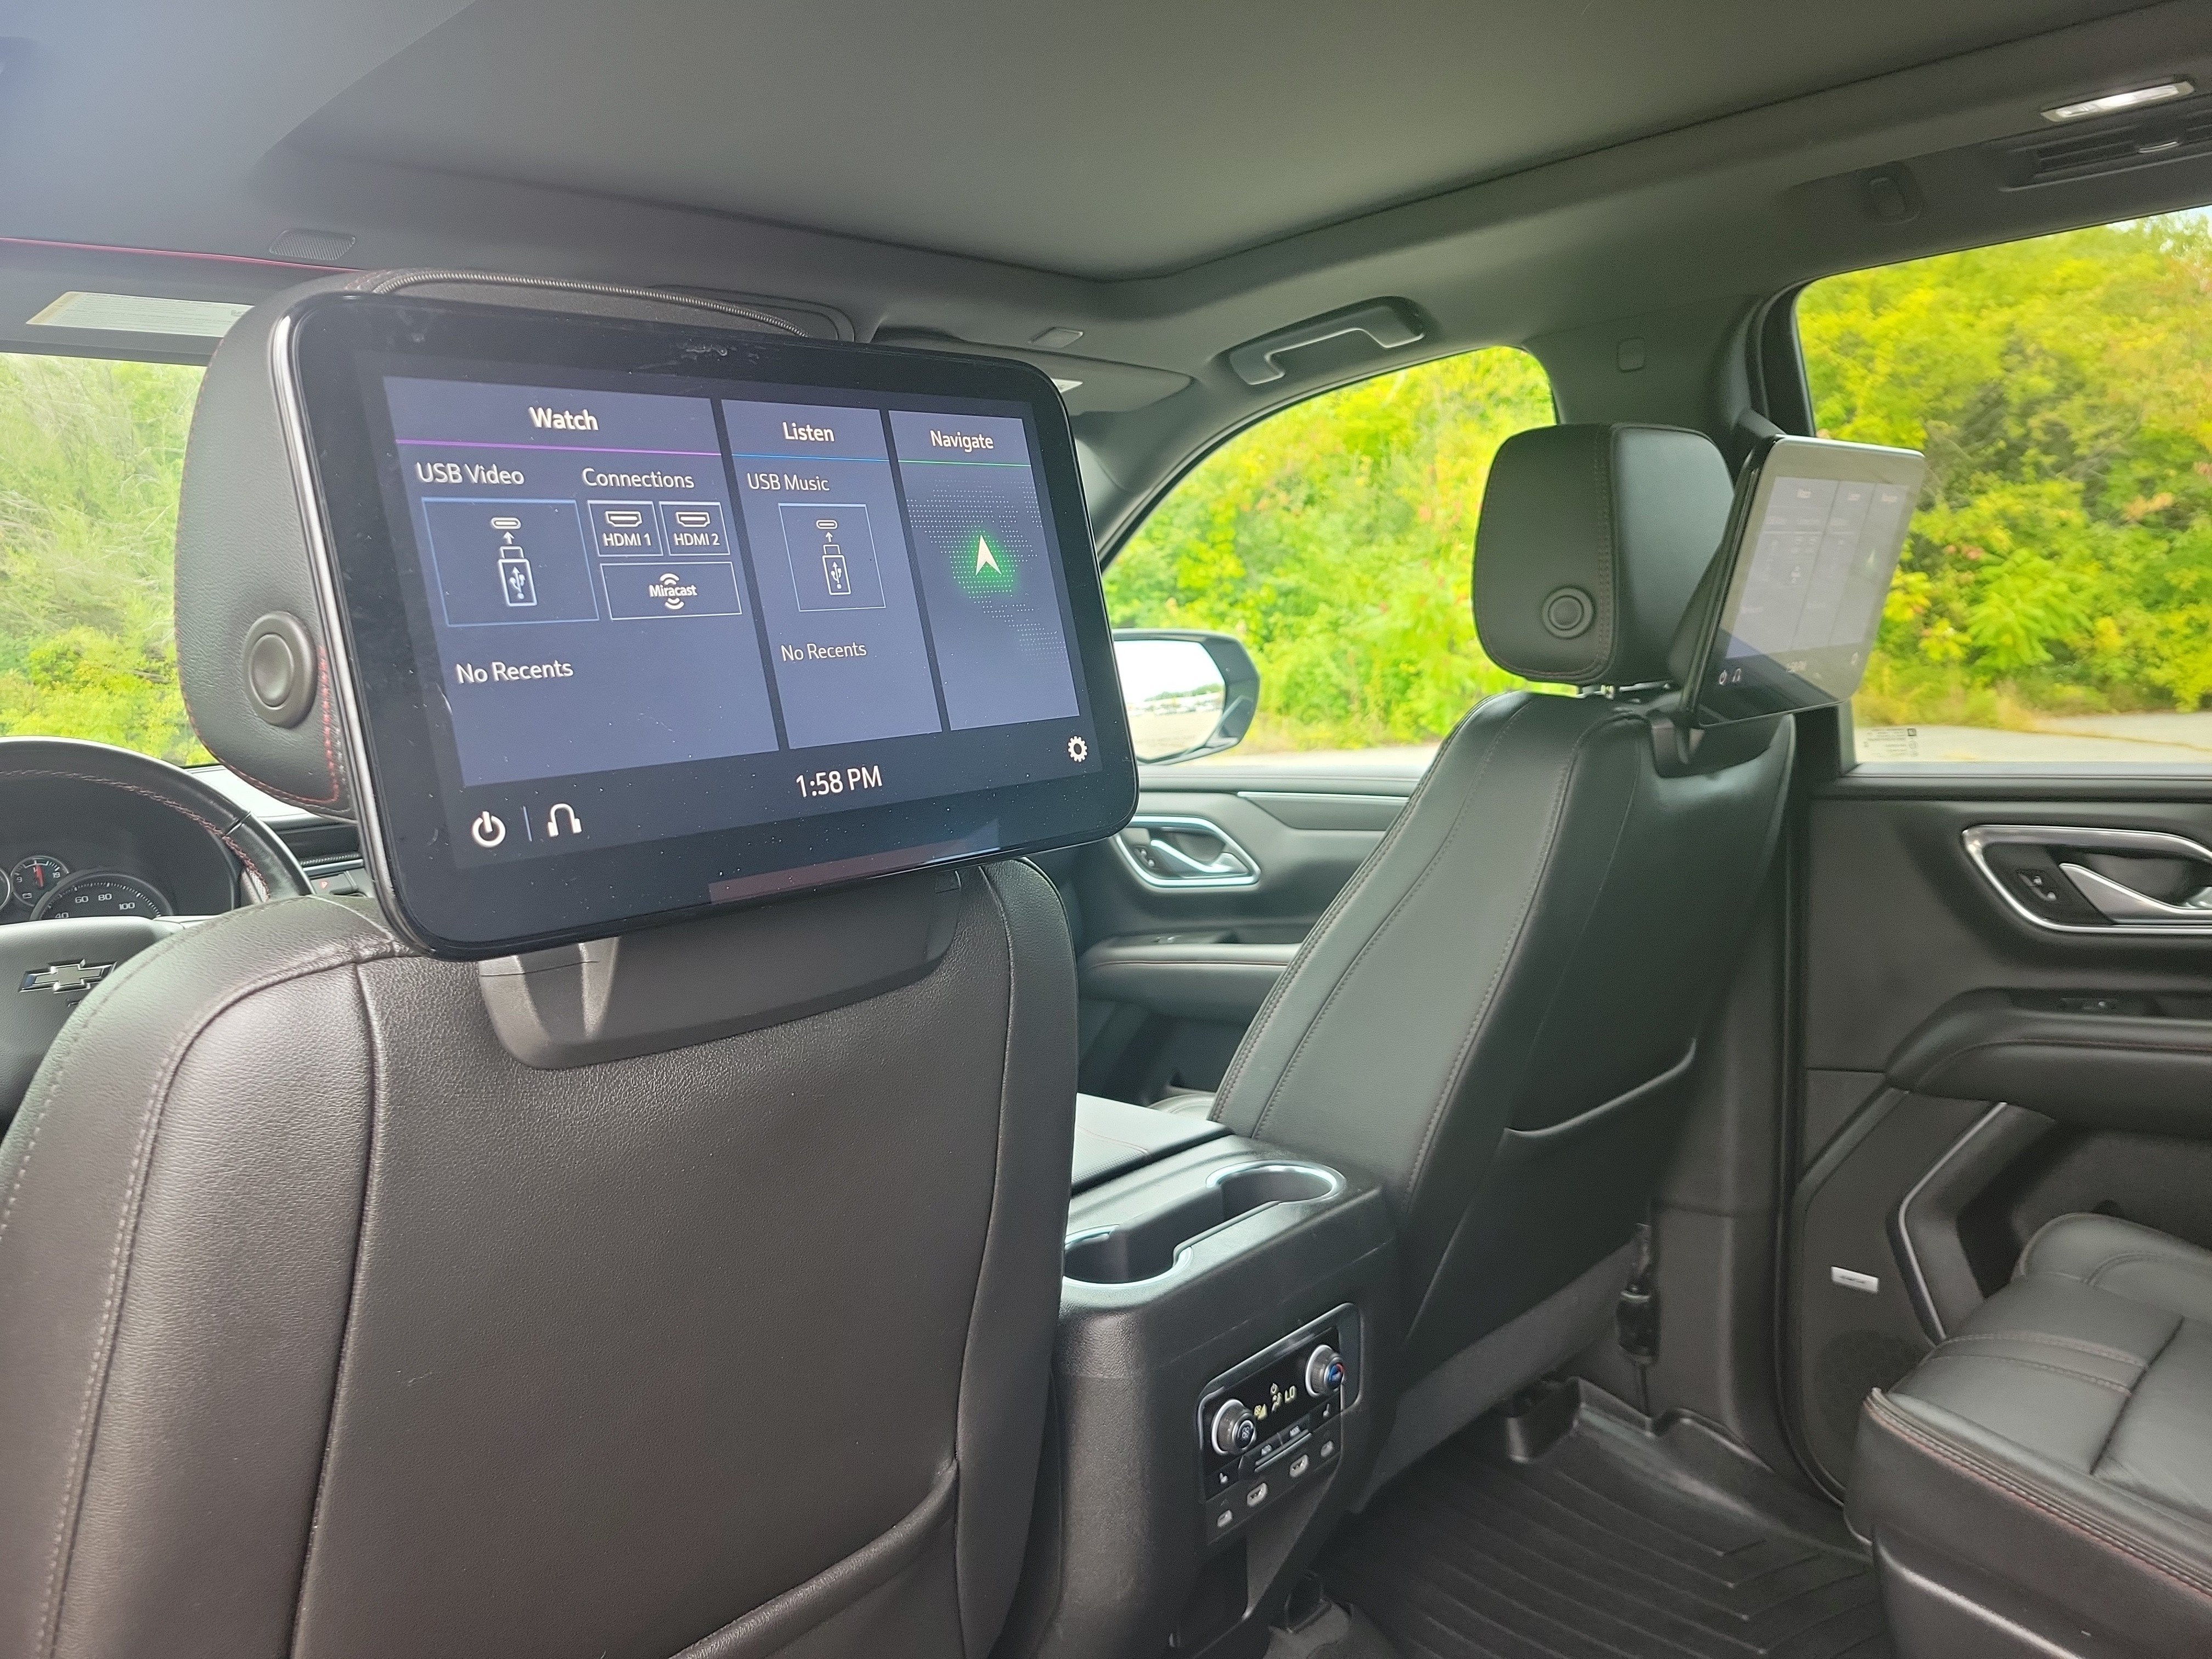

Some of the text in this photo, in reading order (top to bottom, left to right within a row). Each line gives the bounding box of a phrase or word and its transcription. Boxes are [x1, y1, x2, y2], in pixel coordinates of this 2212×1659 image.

[529, 407, 599, 432] Watch
[782, 421, 834, 442] Listen
[930, 430, 995, 453] Navigate
[416, 462, 525, 486] USB Video
[582, 468, 695, 489] Connections
[747, 472, 830, 492] USB Music
[603, 532, 652, 547] HDMI 1
[674, 532, 720, 546] HDMI 2
[648, 584, 698, 598] Miracast
[781, 641, 867, 662] No Recents
[456, 660, 574, 684] No Recents
[796, 765, 883, 798] 1:58 PM
[119, 902, 136, 910] 100
